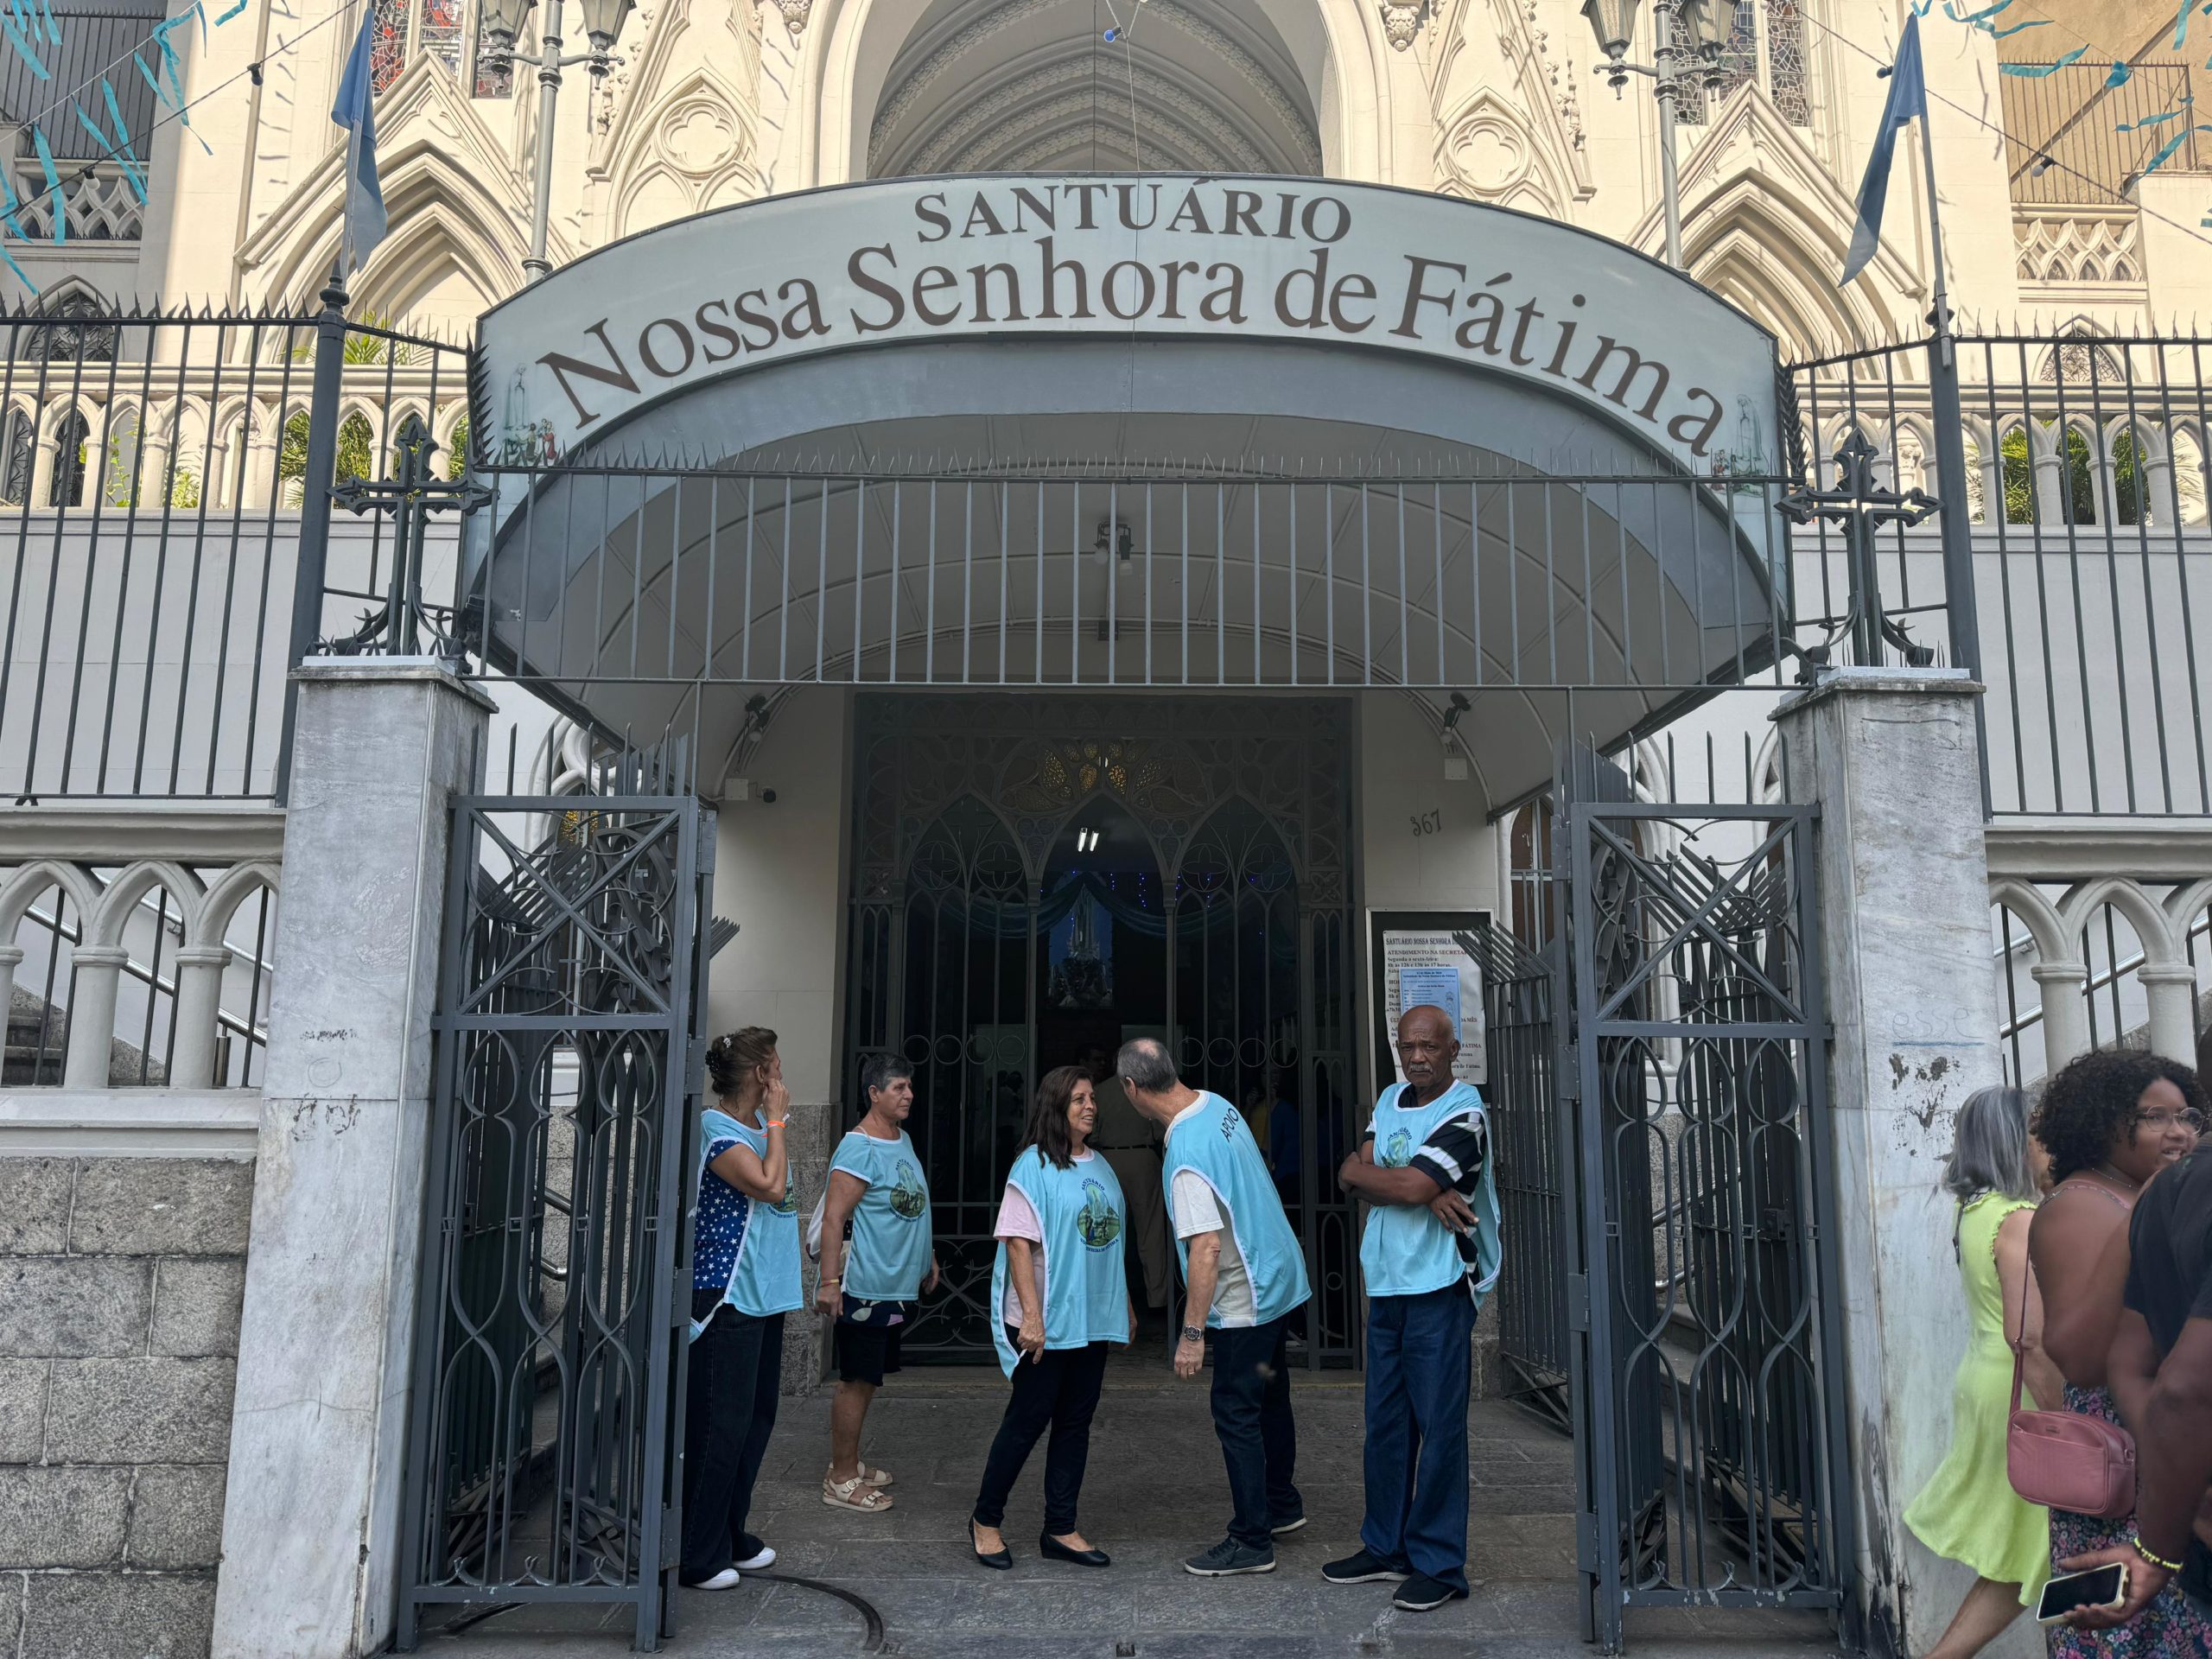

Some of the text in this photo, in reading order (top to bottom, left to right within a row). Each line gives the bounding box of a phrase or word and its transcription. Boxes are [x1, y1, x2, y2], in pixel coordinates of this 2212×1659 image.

[913, 176, 1351, 244] SANTUÁRIO
[535, 235, 1723, 457] Nossa Senhora de Fátima
[1410, 808, 1441, 837] 367
[1220, 1107, 1239, 1144] APOIO
